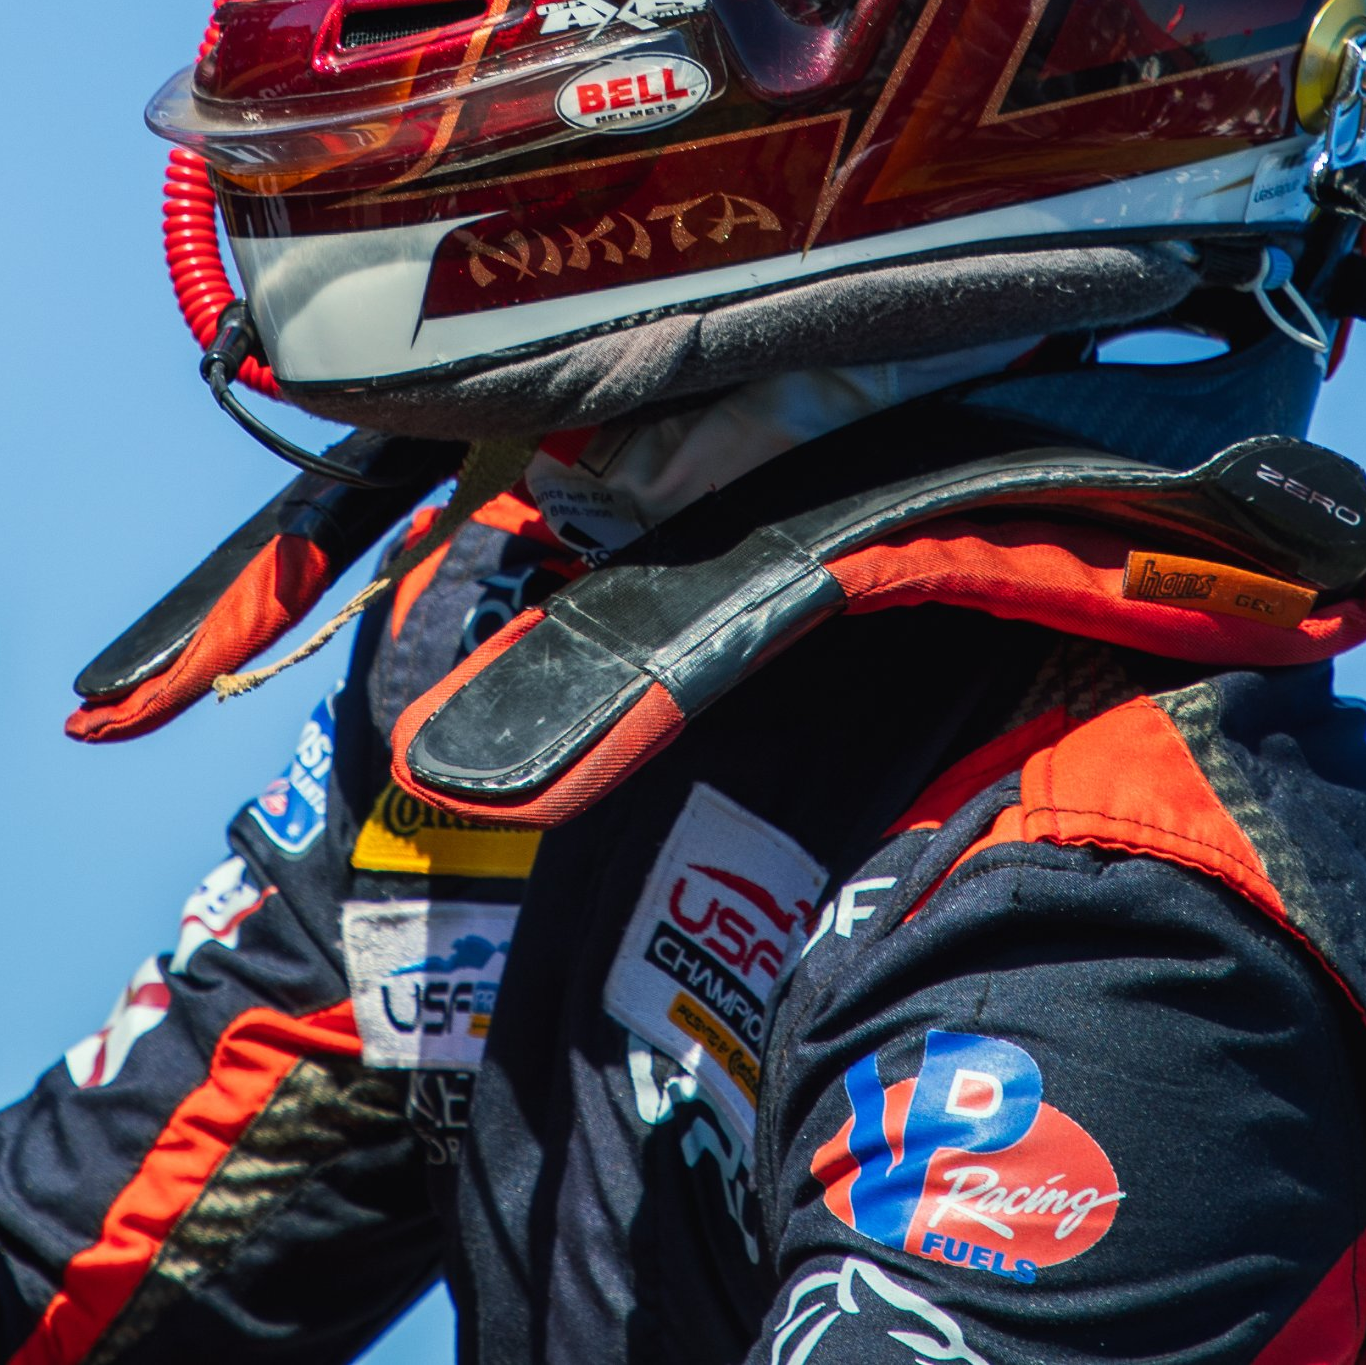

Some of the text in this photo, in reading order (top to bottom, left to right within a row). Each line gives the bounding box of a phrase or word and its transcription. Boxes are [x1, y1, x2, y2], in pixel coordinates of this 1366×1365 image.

[576, 68, 689, 115] BELL
[595, 103, 677, 124] HELMETS
[453, 191, 783, 288] NIKITA
[1256, 463, 1361, 527] ZERO
[1138, 560, 1218, 600] hans
[669, 878, 784, 979] USF
[381, 981, 474, 1034] USF
[654, 937, 765, 1040] CHAMPIO
[845, 1029, 1043, 1251] VP
[929, 1165, 1126, 1240] Racing
[921, 1233, 1037, 1284] FUELS
